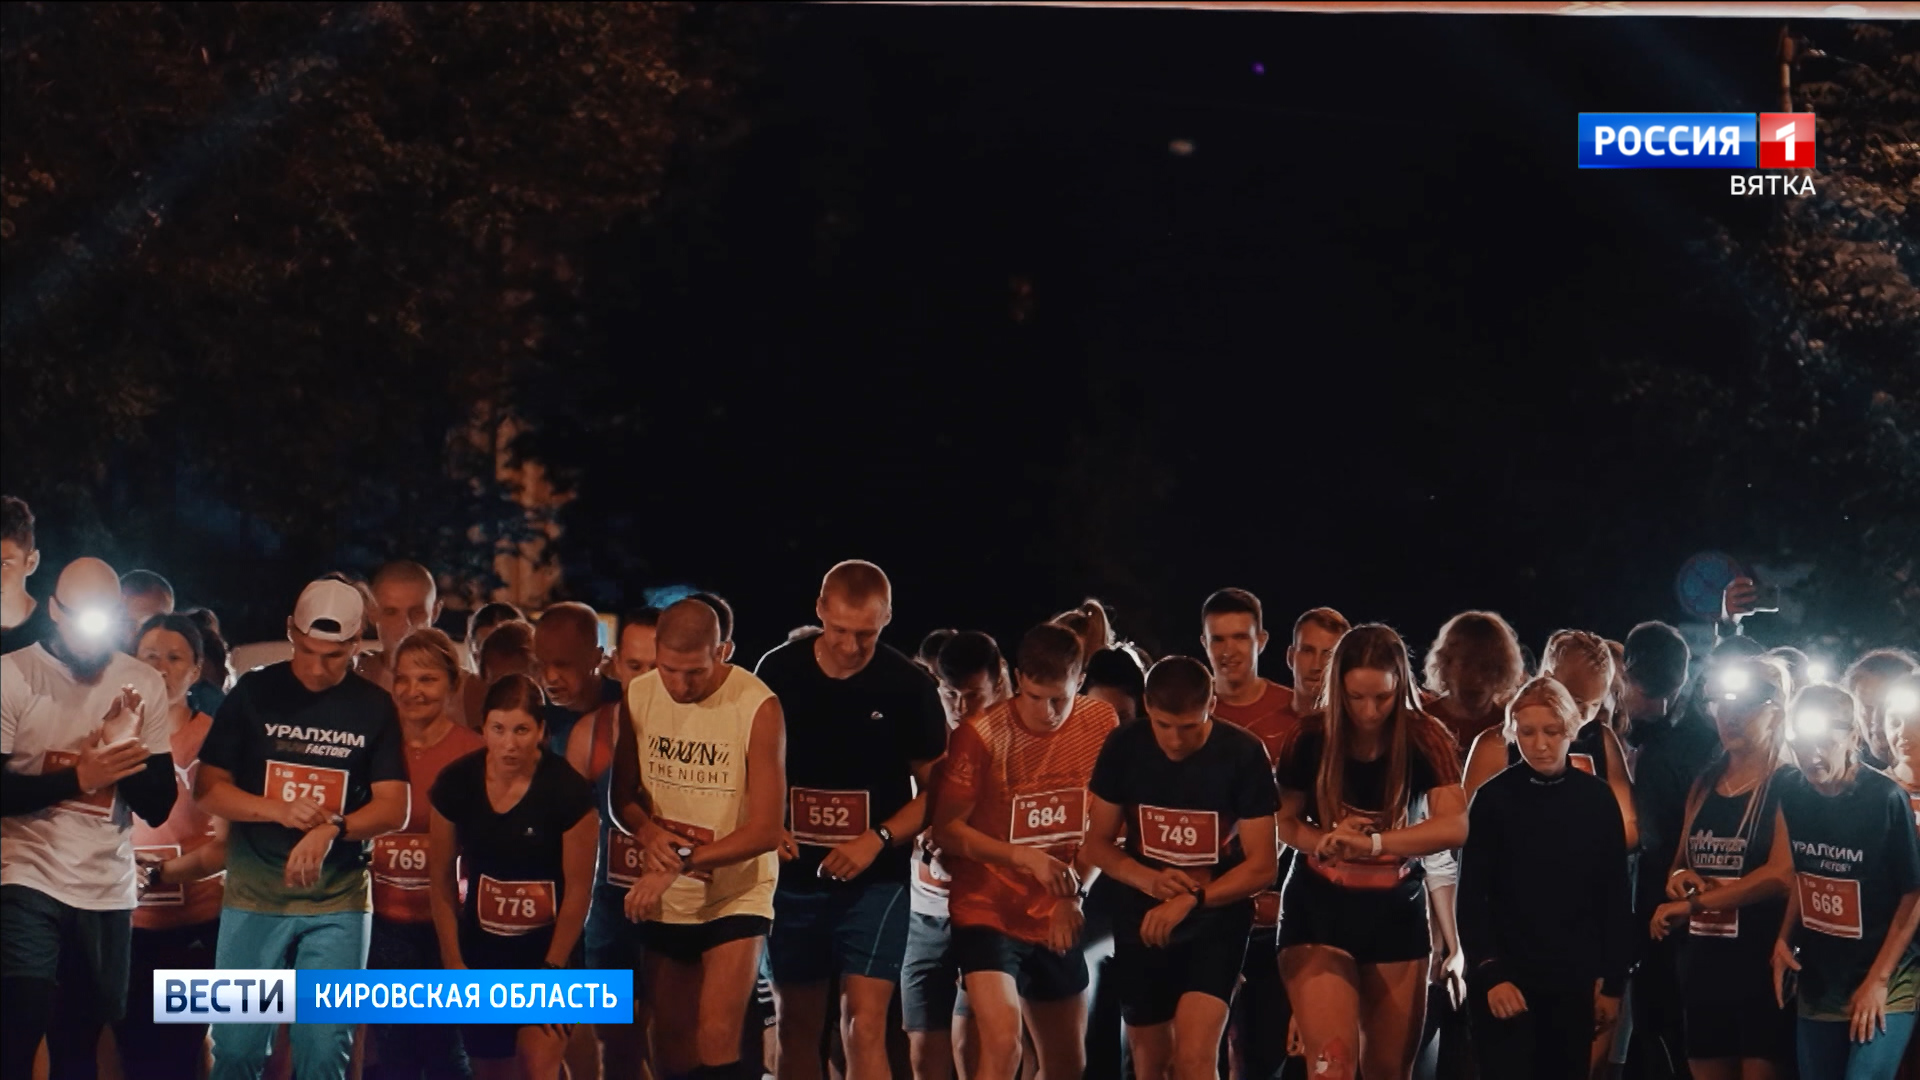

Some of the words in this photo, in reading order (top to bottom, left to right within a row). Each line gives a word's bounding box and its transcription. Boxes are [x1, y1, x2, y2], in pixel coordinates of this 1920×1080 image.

[264, 723, 366, 748] УРАЛХИМ
[305, 743, 352, 758] FACTORY
[658, 736, 716, 767] RUN
[648, 761, 673, 778] THE
[678, 768, 729, 784] NIGHT
[282, 781, 326, 806] 675
[809, 805, 850, 827] 552
[1028, 805, 1067, 829] 684
[1158, 823, 1198, 847] 749
[387, 849, 427, 871] 769
[494, 896, 536, 919] 778
[1811, 891, 1844, 916] 668
